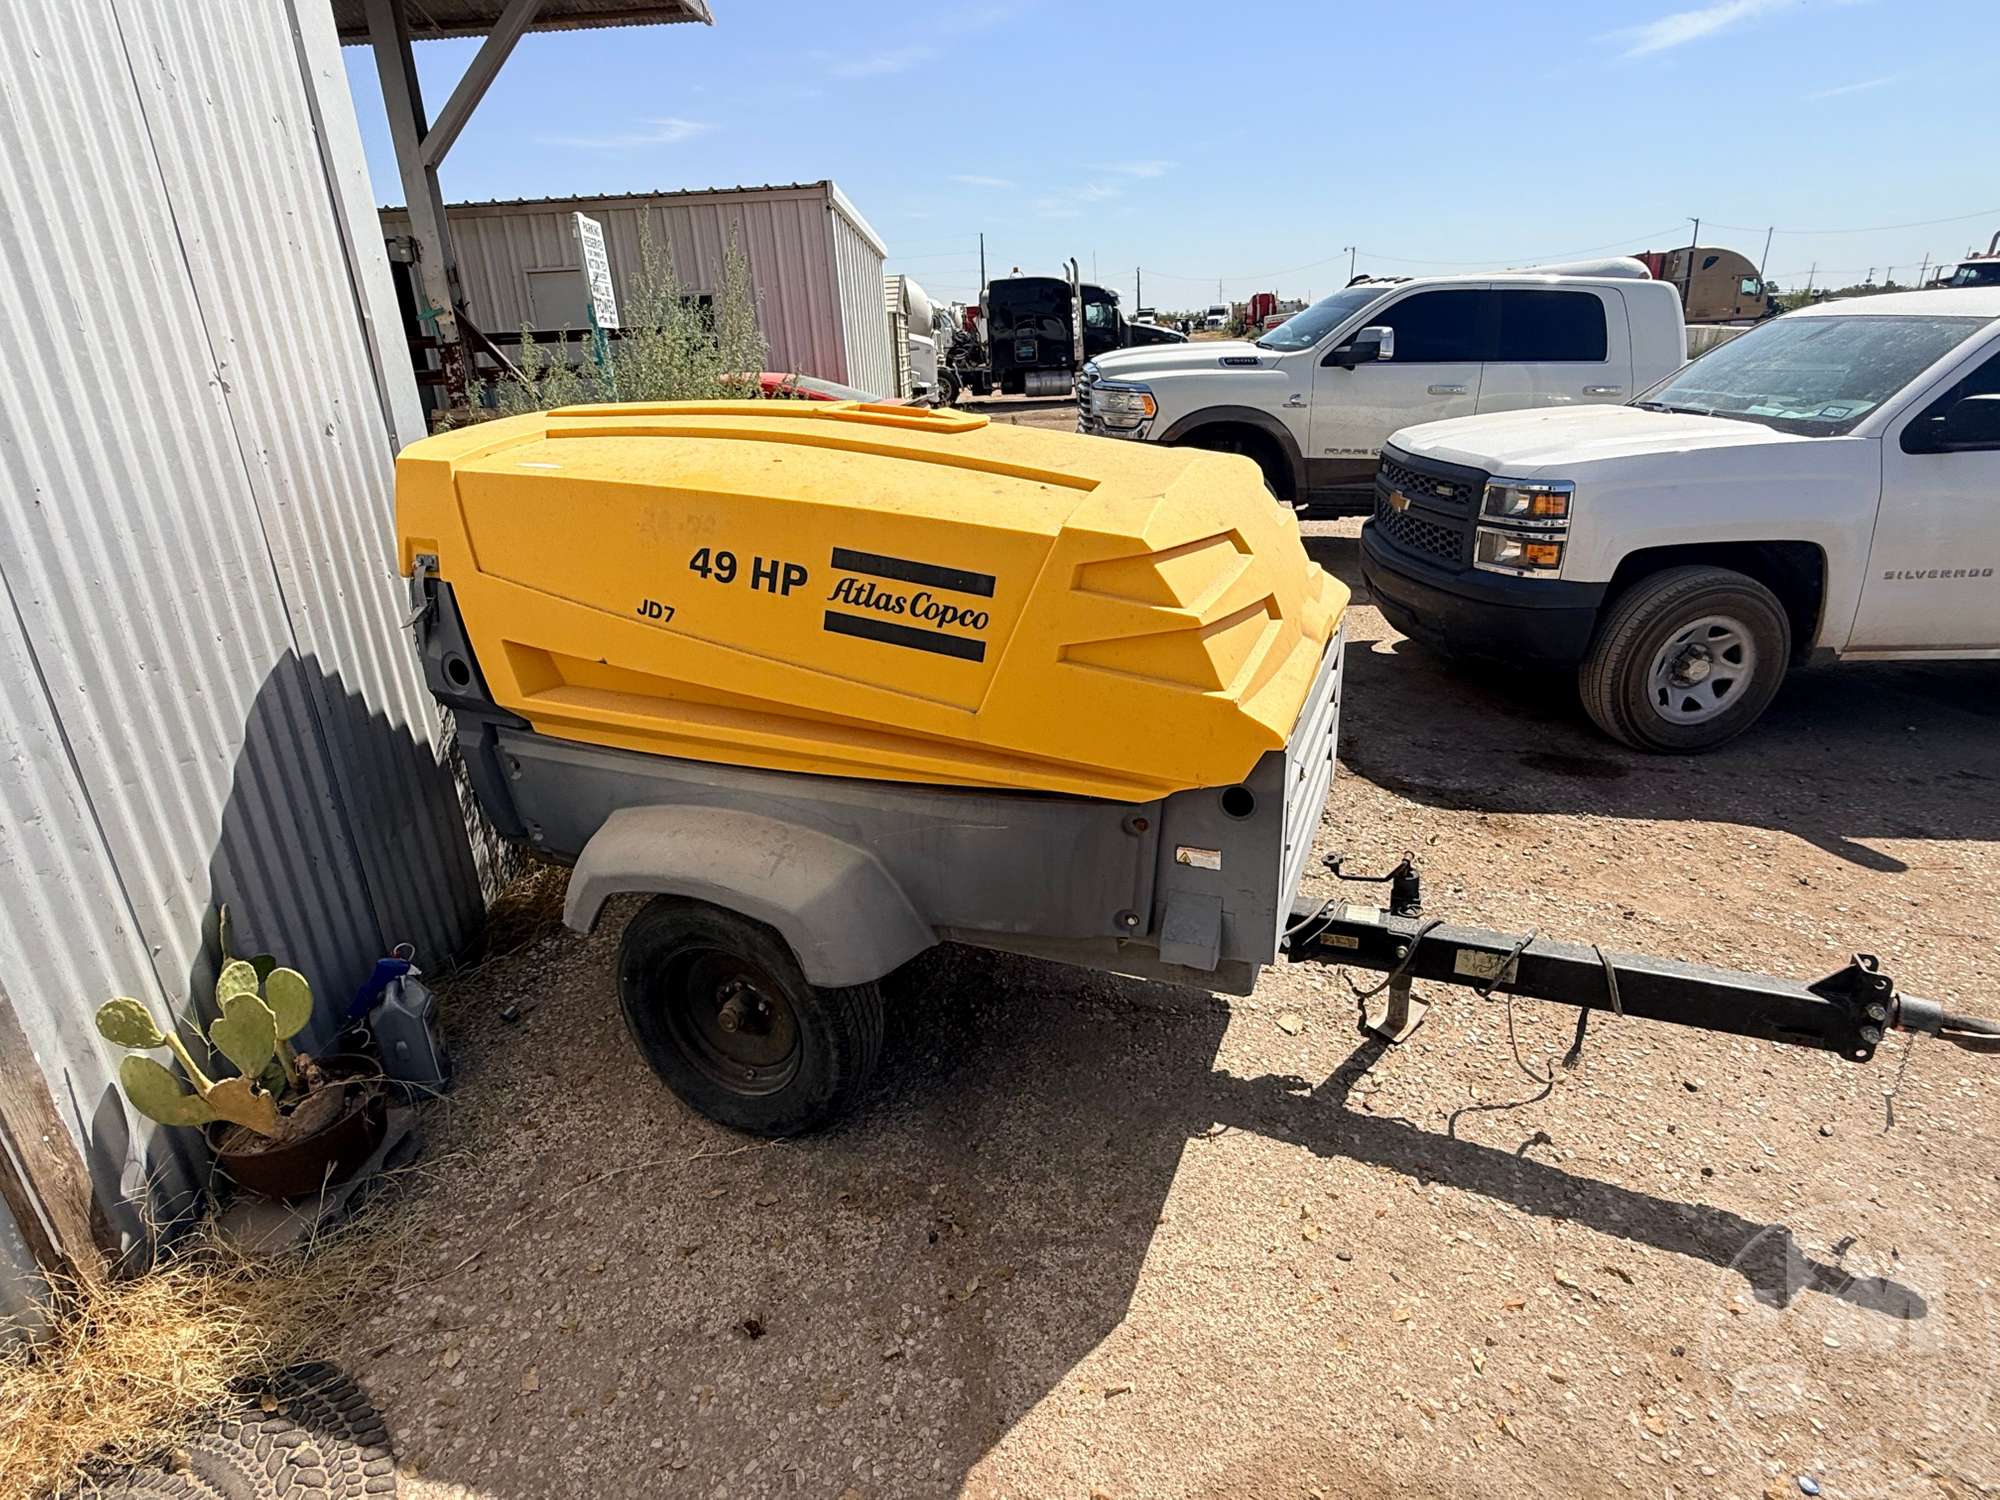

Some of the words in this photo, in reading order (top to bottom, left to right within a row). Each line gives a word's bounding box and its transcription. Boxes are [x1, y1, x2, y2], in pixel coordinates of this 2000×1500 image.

[689, 547, 738, 585] 49
[750, 556, 809, 597] HP
[1883, 568, 1994, 580] SILVERADO
[637, 598, 676, 624] JD7
[827, 577, 906, 615] Atlas
[909, 592, 990, 631] Copco
